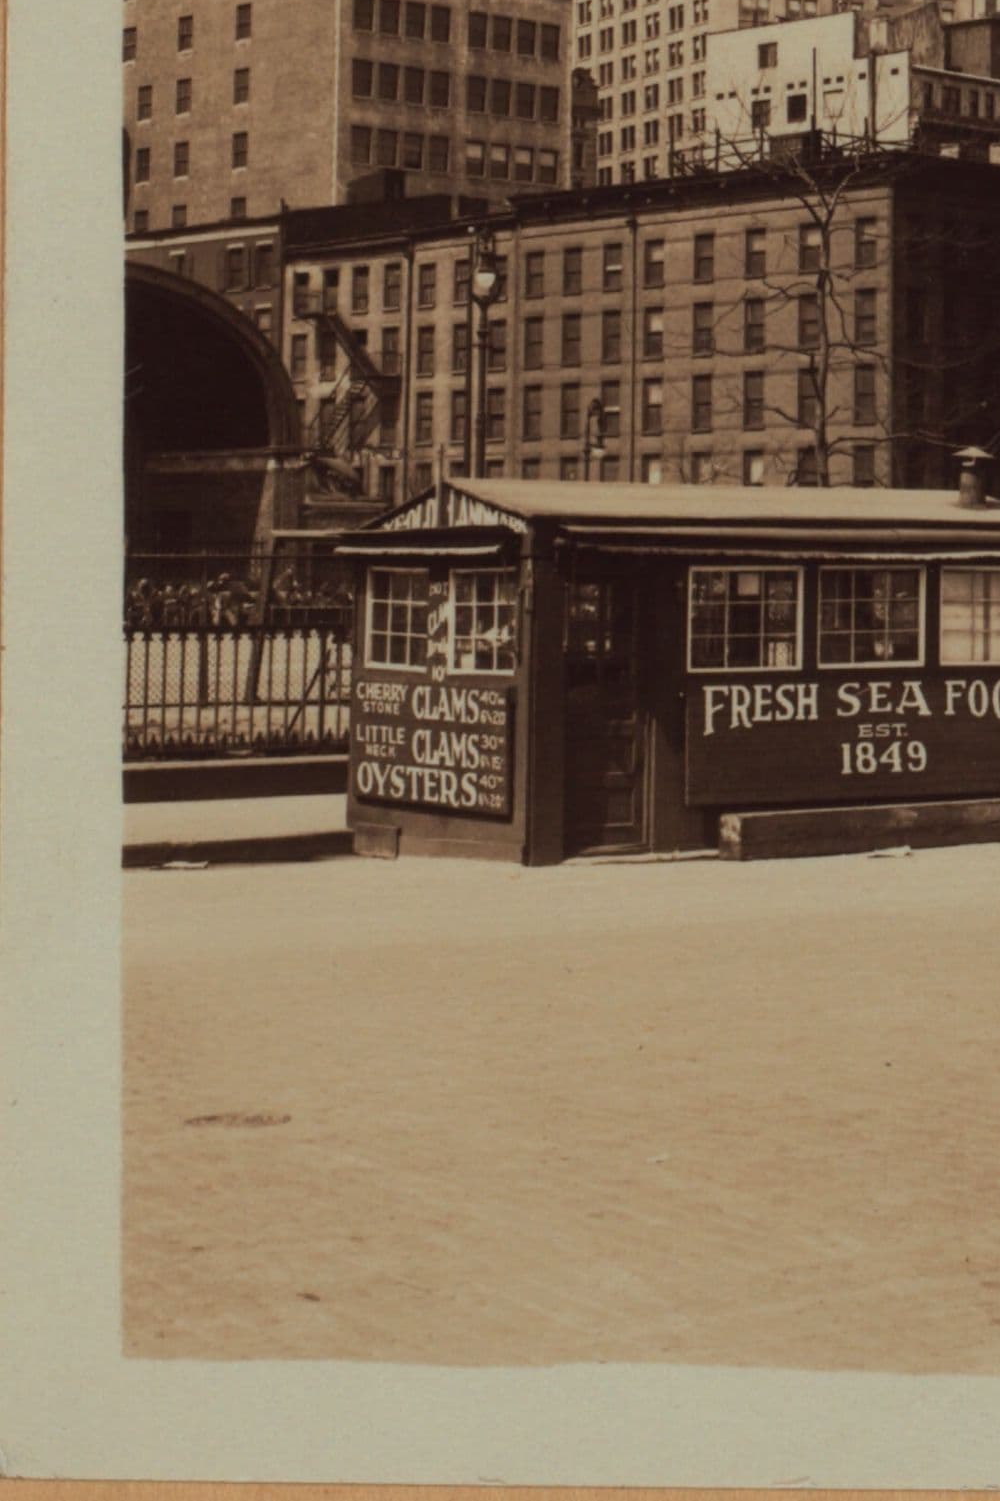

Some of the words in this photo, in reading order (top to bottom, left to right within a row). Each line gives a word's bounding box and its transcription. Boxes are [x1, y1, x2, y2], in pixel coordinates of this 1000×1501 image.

[356, 682, 408, 701] CHERRY
[412, 685, 480, 724] CLAMS
[363, 701, 400, 715] STONE
[703, 684, 819, 736] FRESH
[836, 681, 932, 717] SEA
[356, 724, 406, 745] LITTLE
[858, 723, 909, 738] EST.
[365, 744, 396, 758] NECK
[412, 729, 480, 769] CLAMS
[841, 741, 928, 775] 1849
[357, 761, 478, 807] OYSTERS
